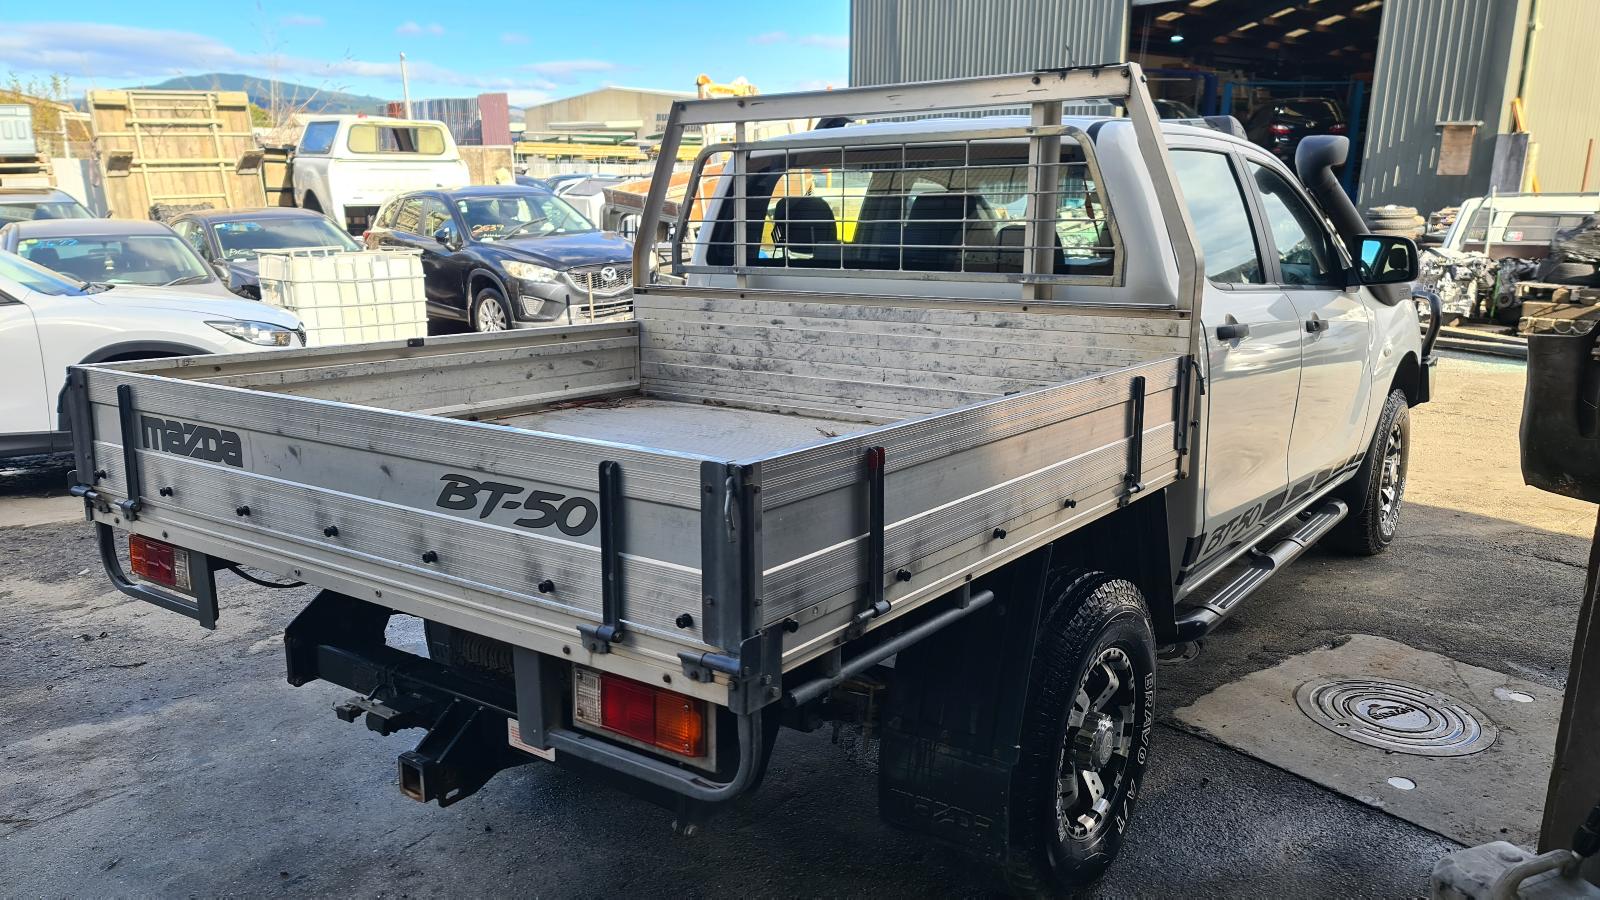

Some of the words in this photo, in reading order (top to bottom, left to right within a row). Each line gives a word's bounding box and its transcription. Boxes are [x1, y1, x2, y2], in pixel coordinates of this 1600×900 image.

[436, 474, 598, 537] BT-50
[1203, 503, 1262, 556] BT-50
[1137, 672, 1153, 765] BRAVO
